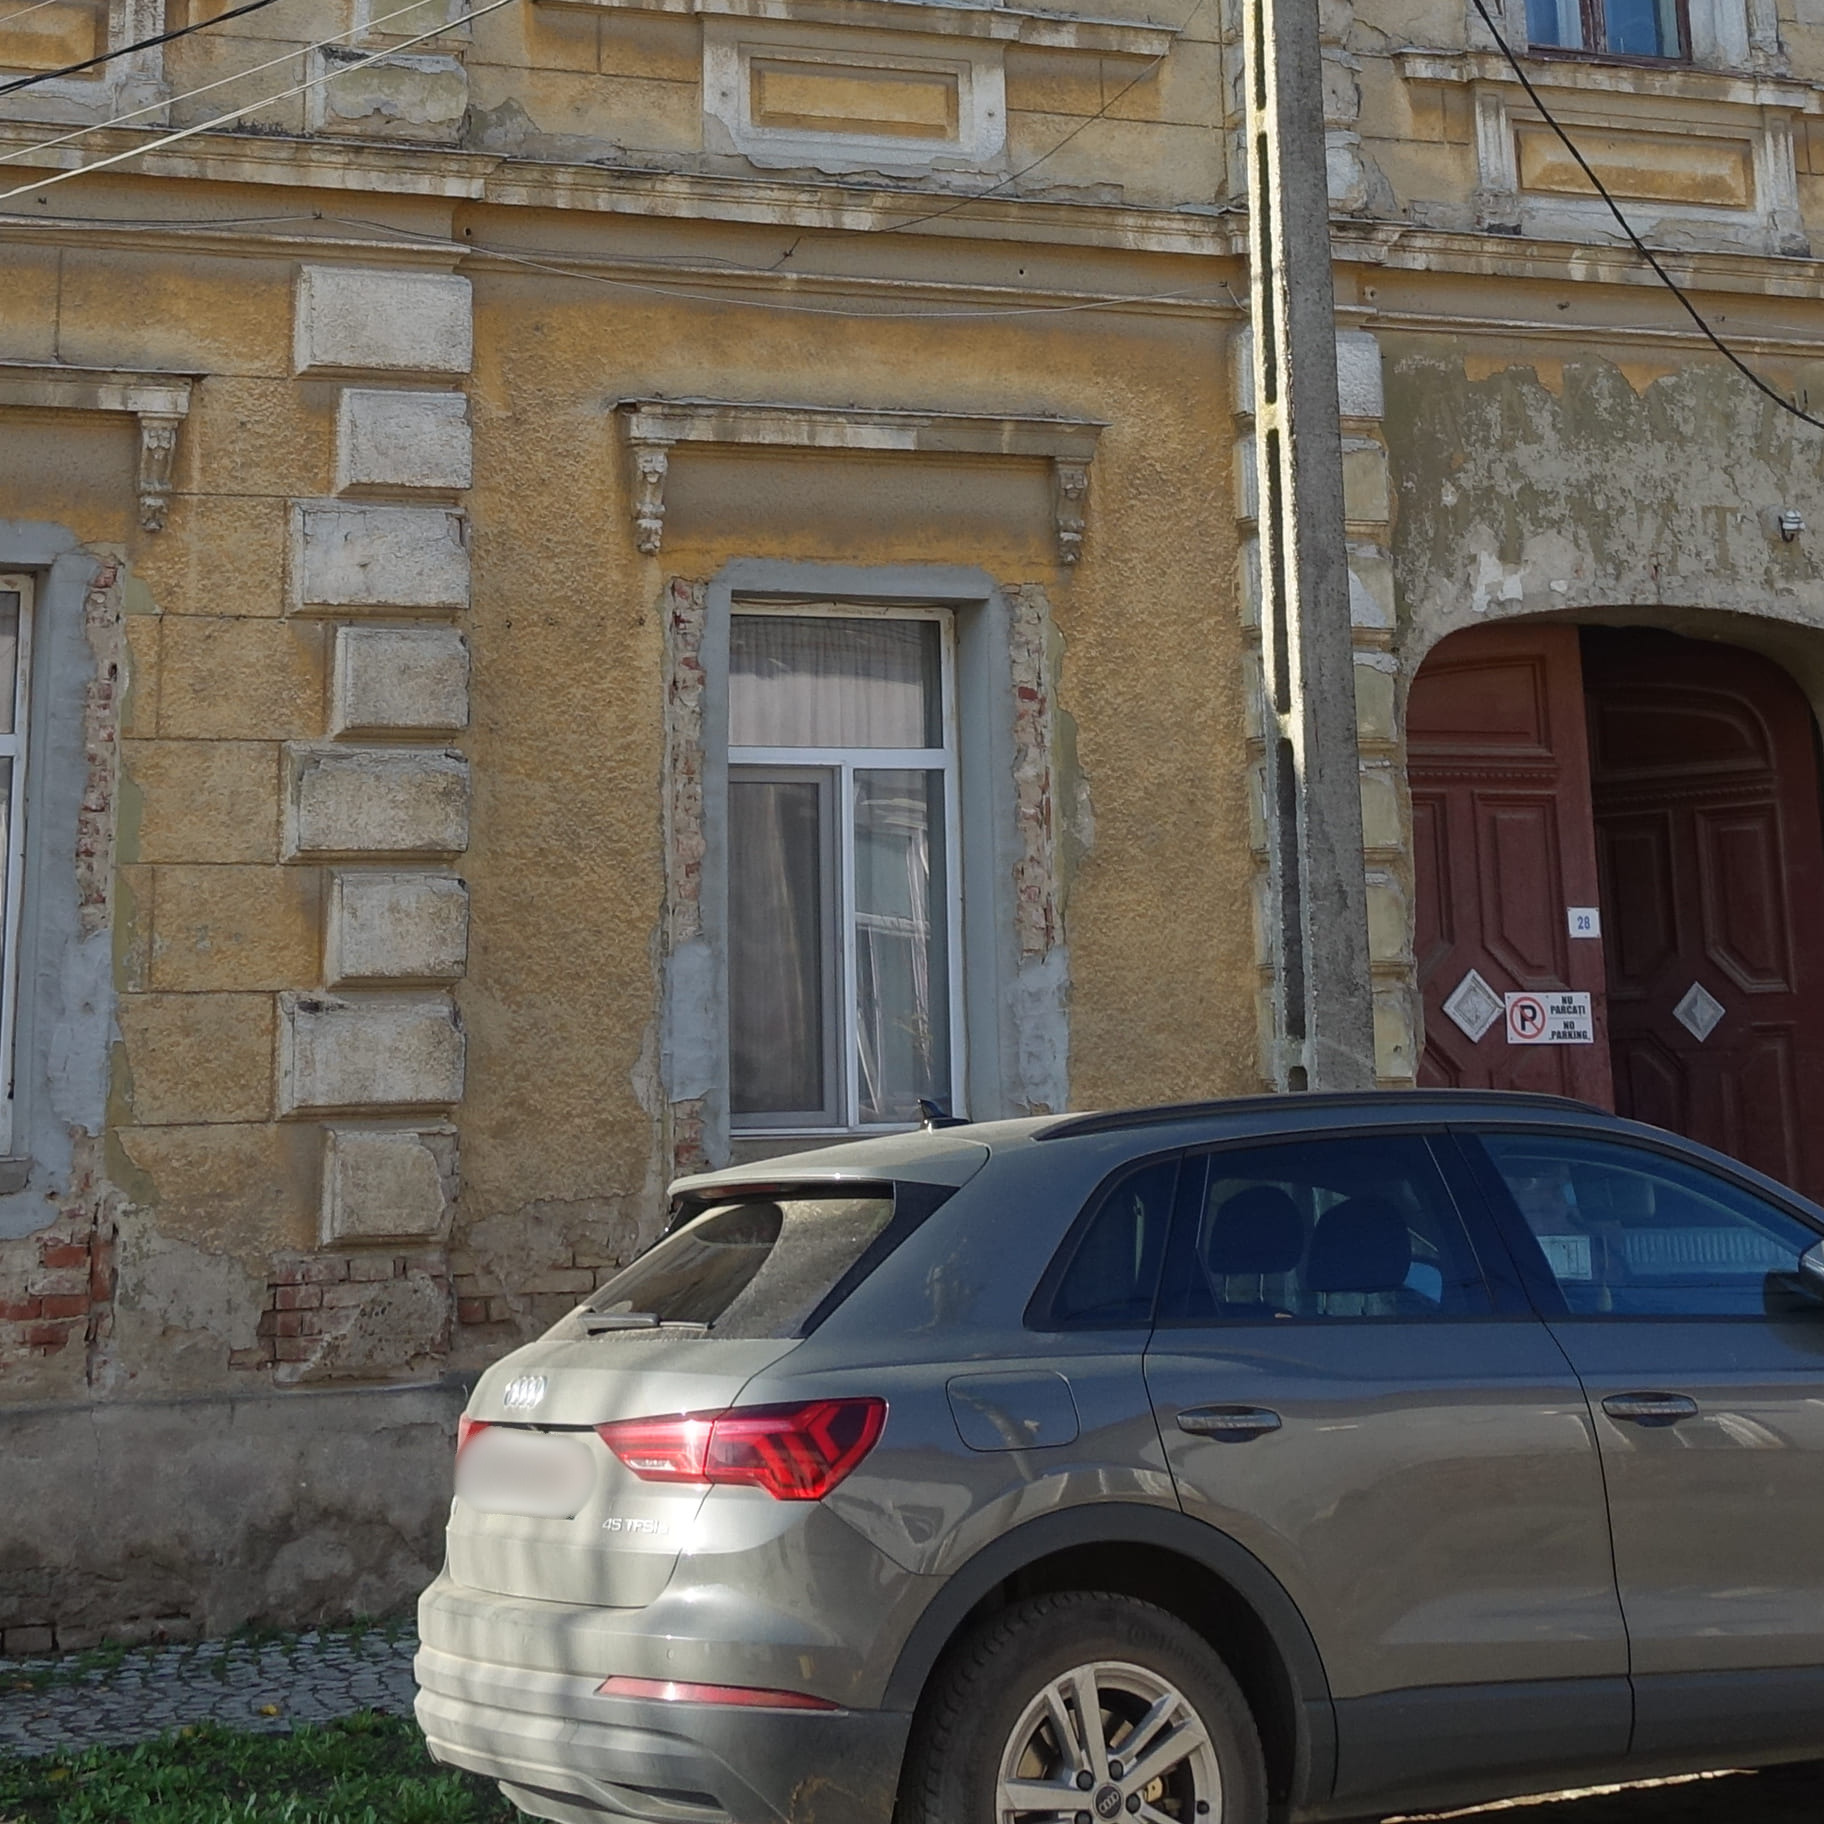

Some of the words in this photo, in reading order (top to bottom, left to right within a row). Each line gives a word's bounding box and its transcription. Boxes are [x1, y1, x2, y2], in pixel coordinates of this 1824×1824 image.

[1577, 916, 1591, 930] 28
[1561, 996, 1573, 1004] NU
[1563, 1021, 1575, 1029] NO
[1551, 1031, 1587, 1040] PARKING
[602, 1518, 622, 1532] 45
